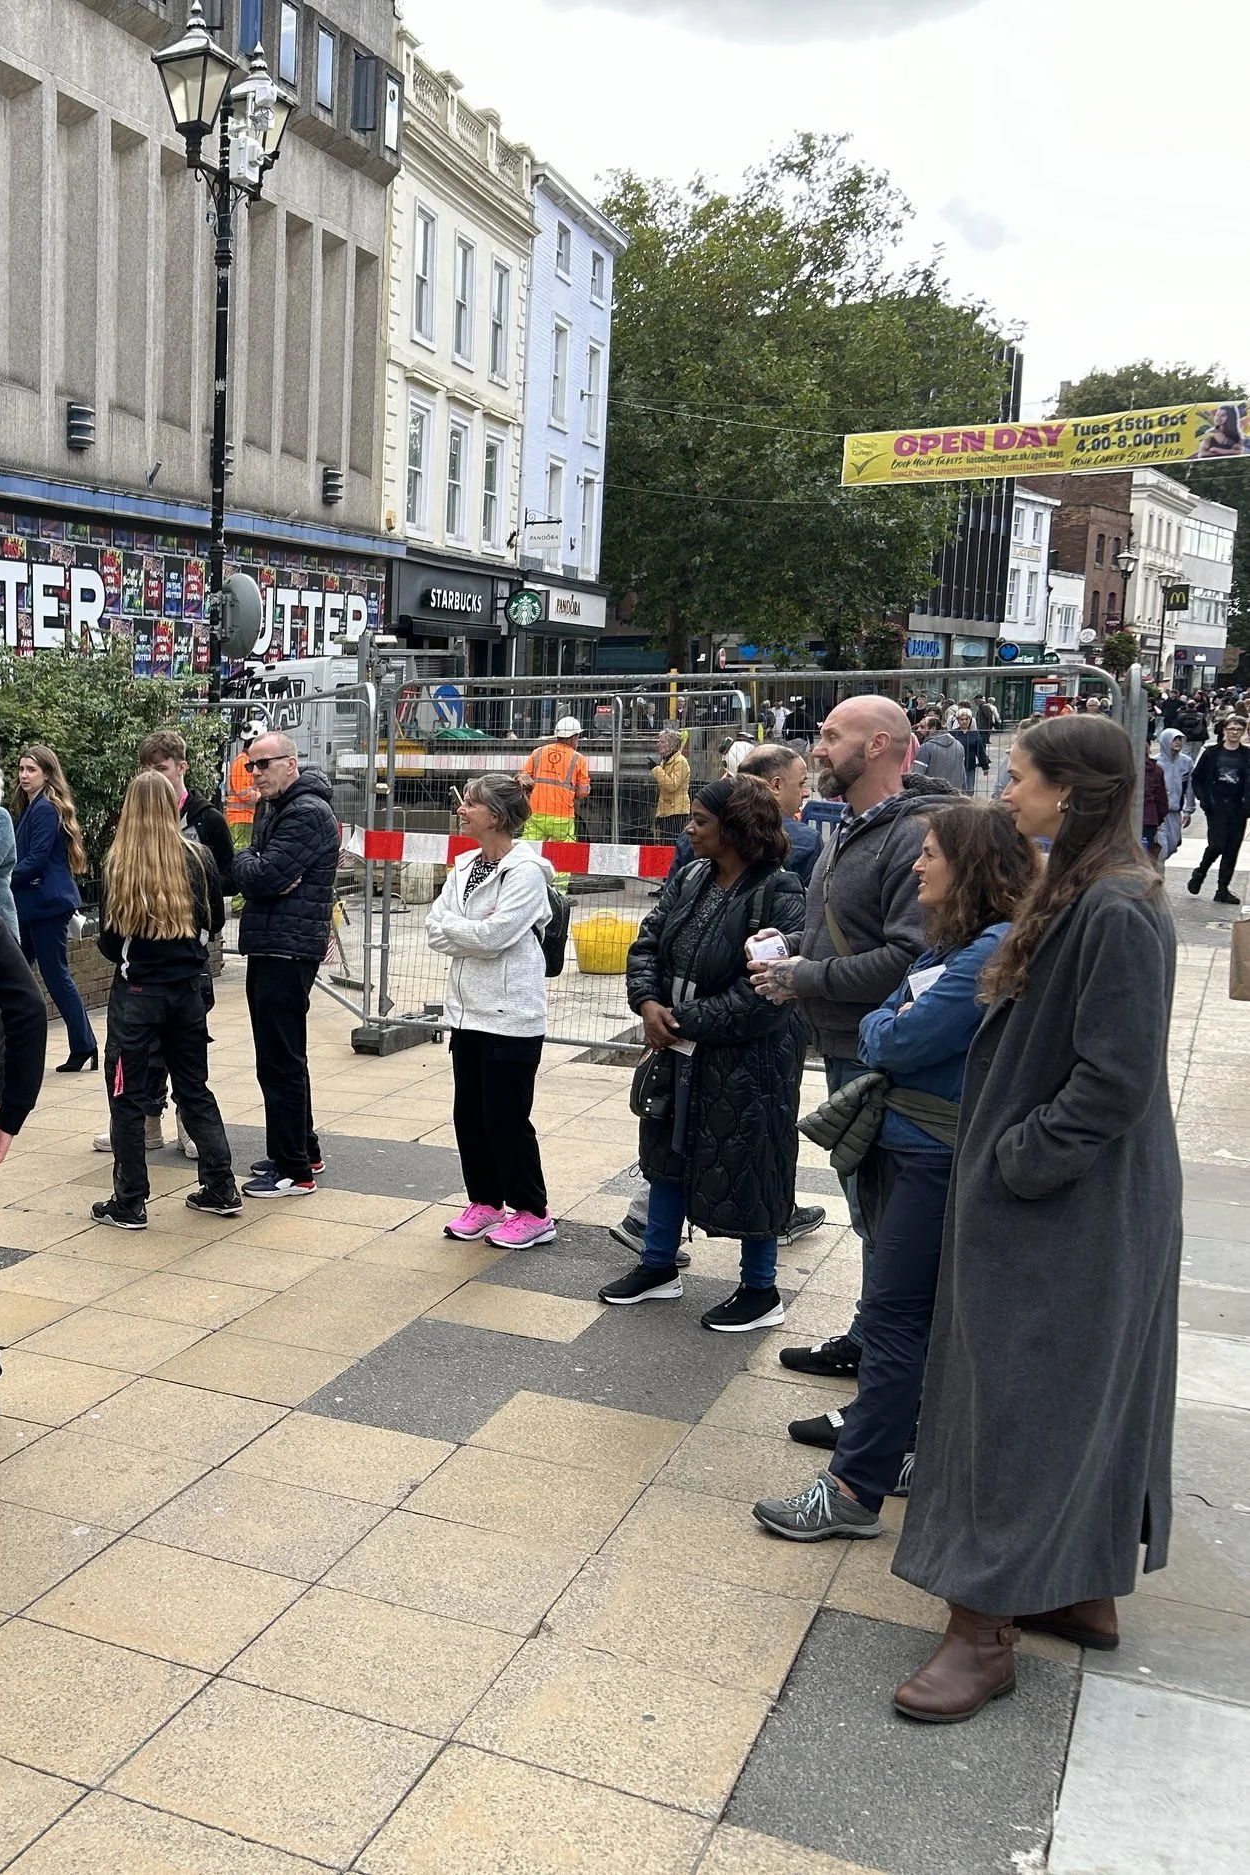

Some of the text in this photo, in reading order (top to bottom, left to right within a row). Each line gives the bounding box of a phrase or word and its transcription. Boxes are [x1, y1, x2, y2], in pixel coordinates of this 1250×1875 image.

[1072, 413, 1187, 437] Tues 15th Oct
[894, 424, 1066, 457] OPEN DAY
[1076, 432, 1181, 453] 4.00-8.00pm
[430, 587, 482, 613] STARBUCKS
[252, 587, 368, 656] UTTER
[914, 639, 941, 657] BARCLAYS
